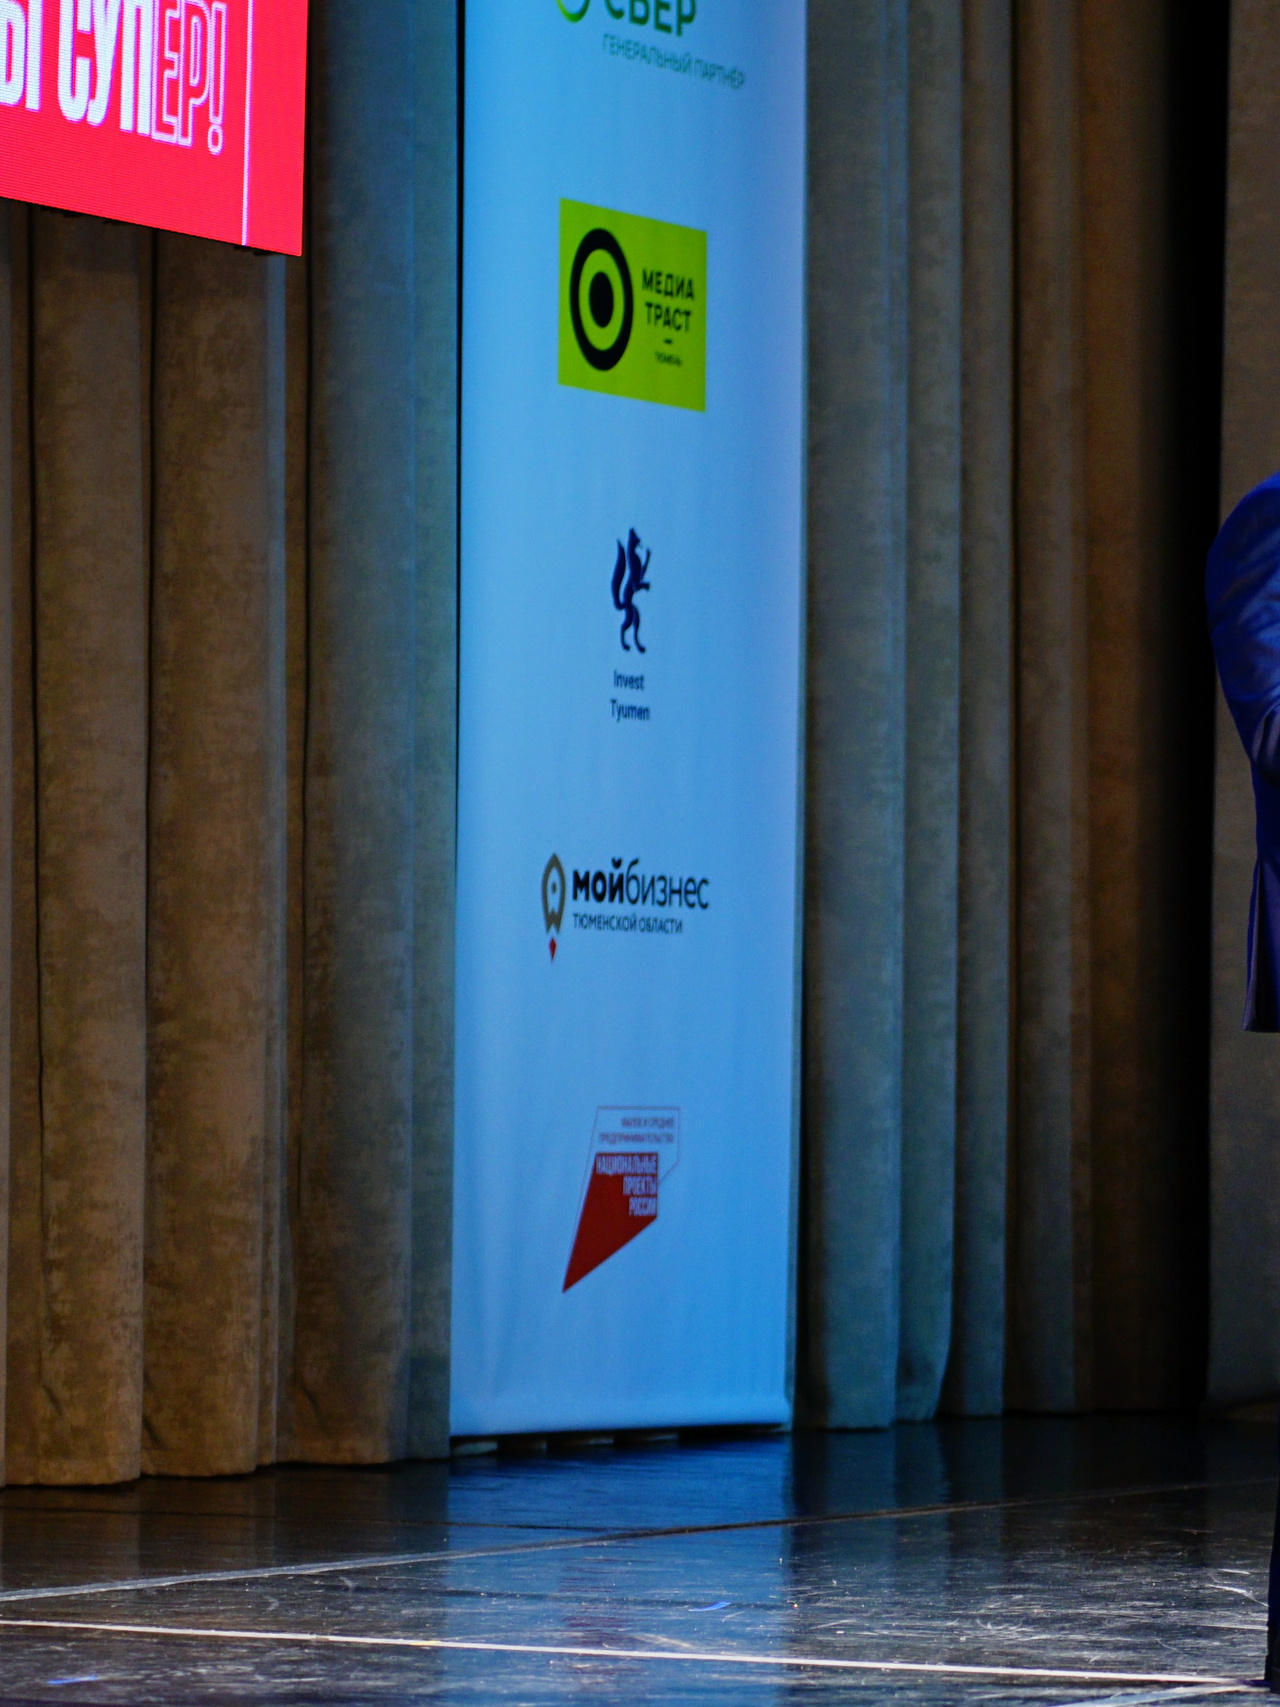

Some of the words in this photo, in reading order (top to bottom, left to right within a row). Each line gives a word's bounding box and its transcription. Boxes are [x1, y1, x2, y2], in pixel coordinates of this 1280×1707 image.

[603, 33, 692, 74] ГЕНЕРАЛЬНЫЙ
[57, 0, 228, 155] СУПЕР!
[641, 268, 695, 300] МЕДИА
[644, 302, 691, 332] ТРАСТ
[613, 669, 645, 691] Invest
[610, 698, 650, 723] Tyumen
[572, 913, 637, 932] ТЮМЕНСКОЙ
[638, 916, 683, 934] ОБЛАСТИ
